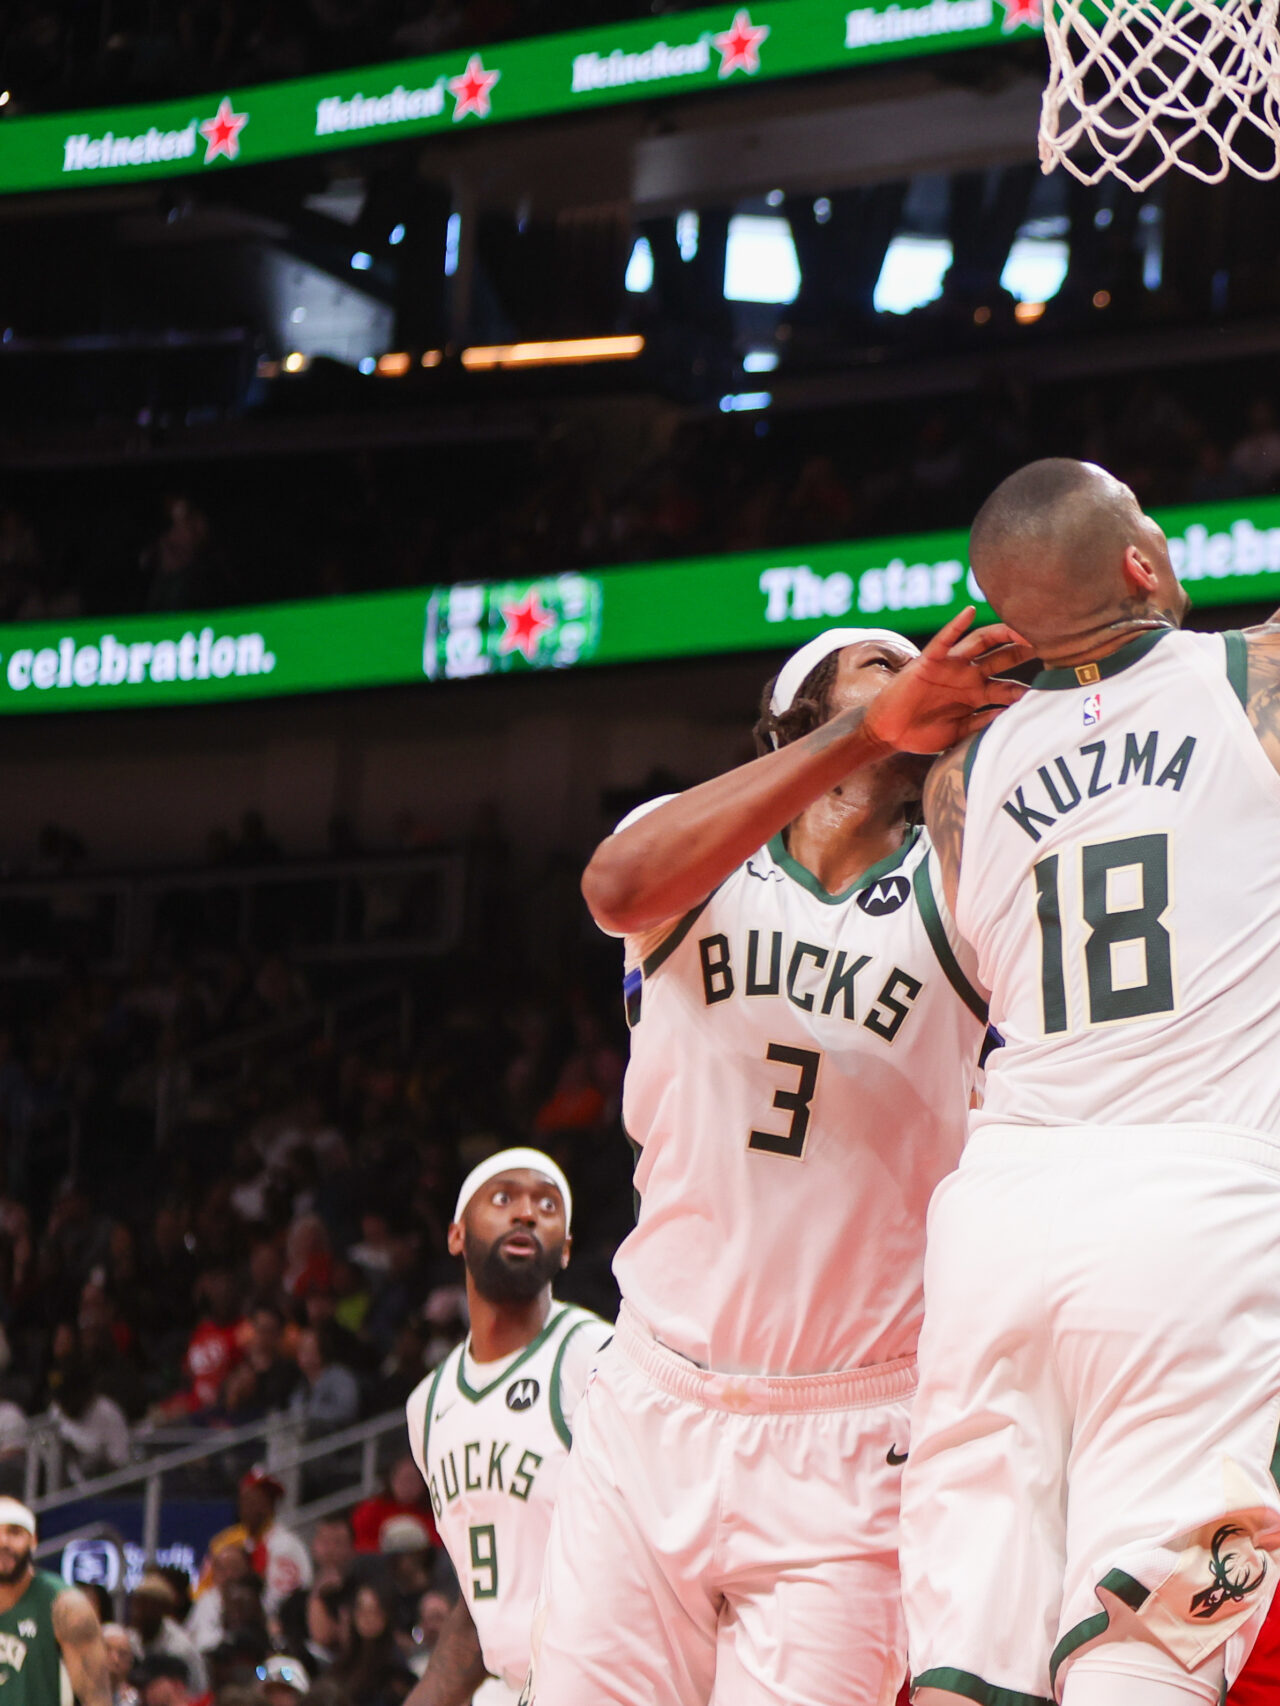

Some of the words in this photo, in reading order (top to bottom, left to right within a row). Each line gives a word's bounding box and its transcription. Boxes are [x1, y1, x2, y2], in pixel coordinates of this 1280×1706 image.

[844, 0, 993, 48] Heineken
[571, 31, 712, 92] Heineken
[315, 75, 446, 135] Heineken
[62, 117, 199, 171] Heineken
[759, 565, 853, 622] The
[857, 558, 963, 613] star
[7, 627, 276, 691] celebration.
[1003, 730, 1196, 842] KUZMA
[1034, 830, 1175, 1040] 18
[699, 929, 923, 1043] BUCKS
[748, 1042, 823, 1161] 3
[430, 1441, 543, 1521] BUCKS
[469, 1524, 497, 1600] 9
